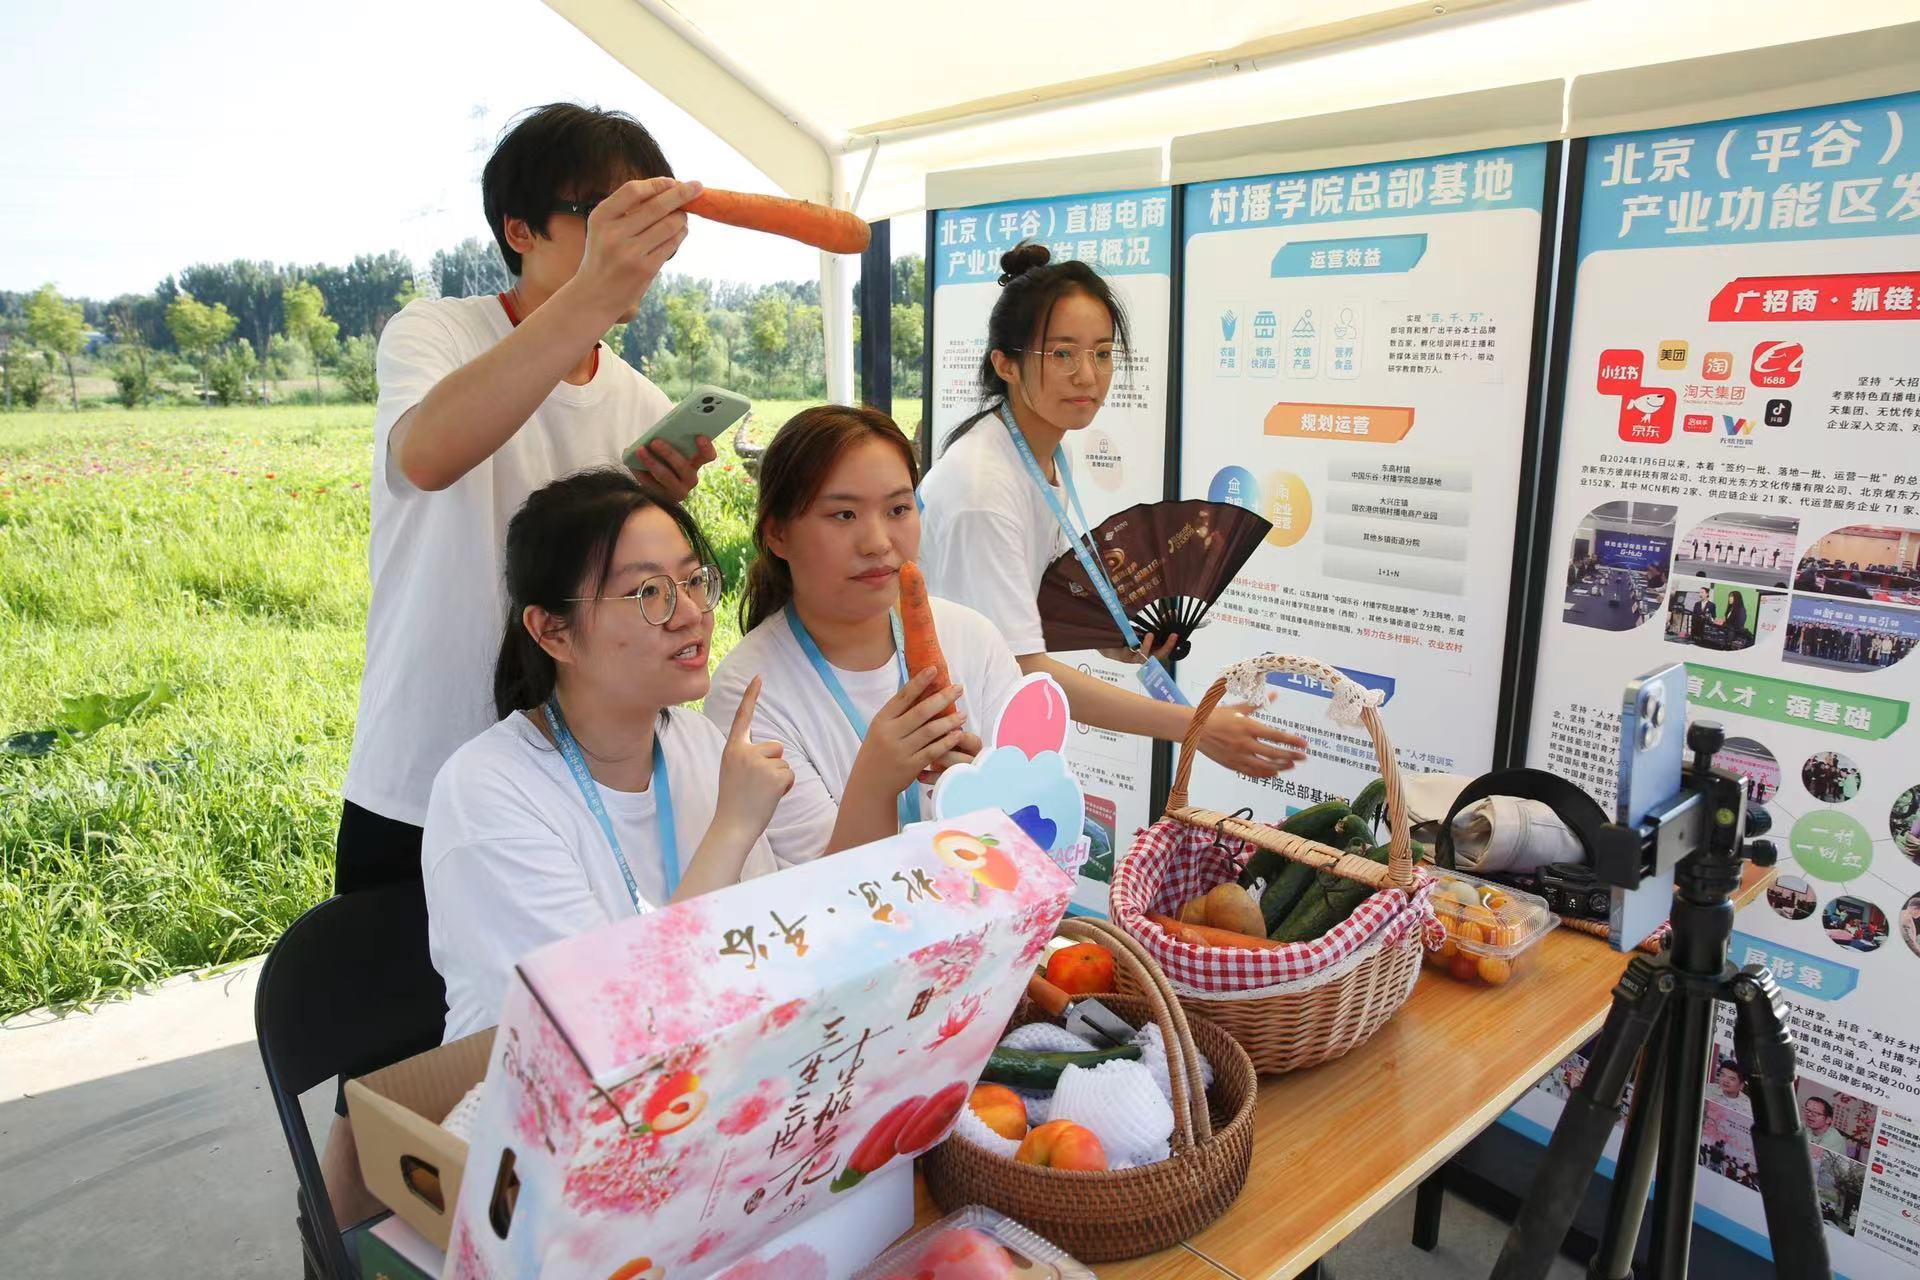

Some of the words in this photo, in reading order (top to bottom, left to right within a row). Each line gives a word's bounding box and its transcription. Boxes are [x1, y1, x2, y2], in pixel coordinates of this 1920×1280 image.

[1601, 111, 1904, 187] 北京（平谷）
[1209, 158, 1514, 225] 村播学院总部基地
[940, 197, 1167, 246] 北京（平谷）直播电商
[949, 236, 1151, 277] 产业功发展概况
[1310, 248, 1382, 269] 运营效益
[1733, 286, 1920, 315] 广招商·抓链
[1219, 358, 1235, 369] 产品
[1293, 358, 1311, 370] 产品
[1660, 349, 1686, 362] 美团
[1601, 365, 1639, 381] 小红书
[1707, 358, 1729, 375] 淘
[1763, 376, 1786, 385] 1688
[1683, 384, 1746, 400] 淘天集团
[1832, 390, 1920, 403] 考察特色直播电
[1300, 413, 1371, 435] 规划运营
[1631, 426, 1660, 438] 京东
[1381, 464, 1411, 474] 东高村镇
[1379, 497, 1409, 508] 大兴庄镇
[1378, 568, 1400, 578] 1+1+N
[1687, 675, 1872, 732] 育人才·强基础
[1050, 843, 1087, 863] ACH
[1728, 946, 1824, 990] 展形象
[1786, 1016, 1920, 1069] 能区媒体通气会、村播学
